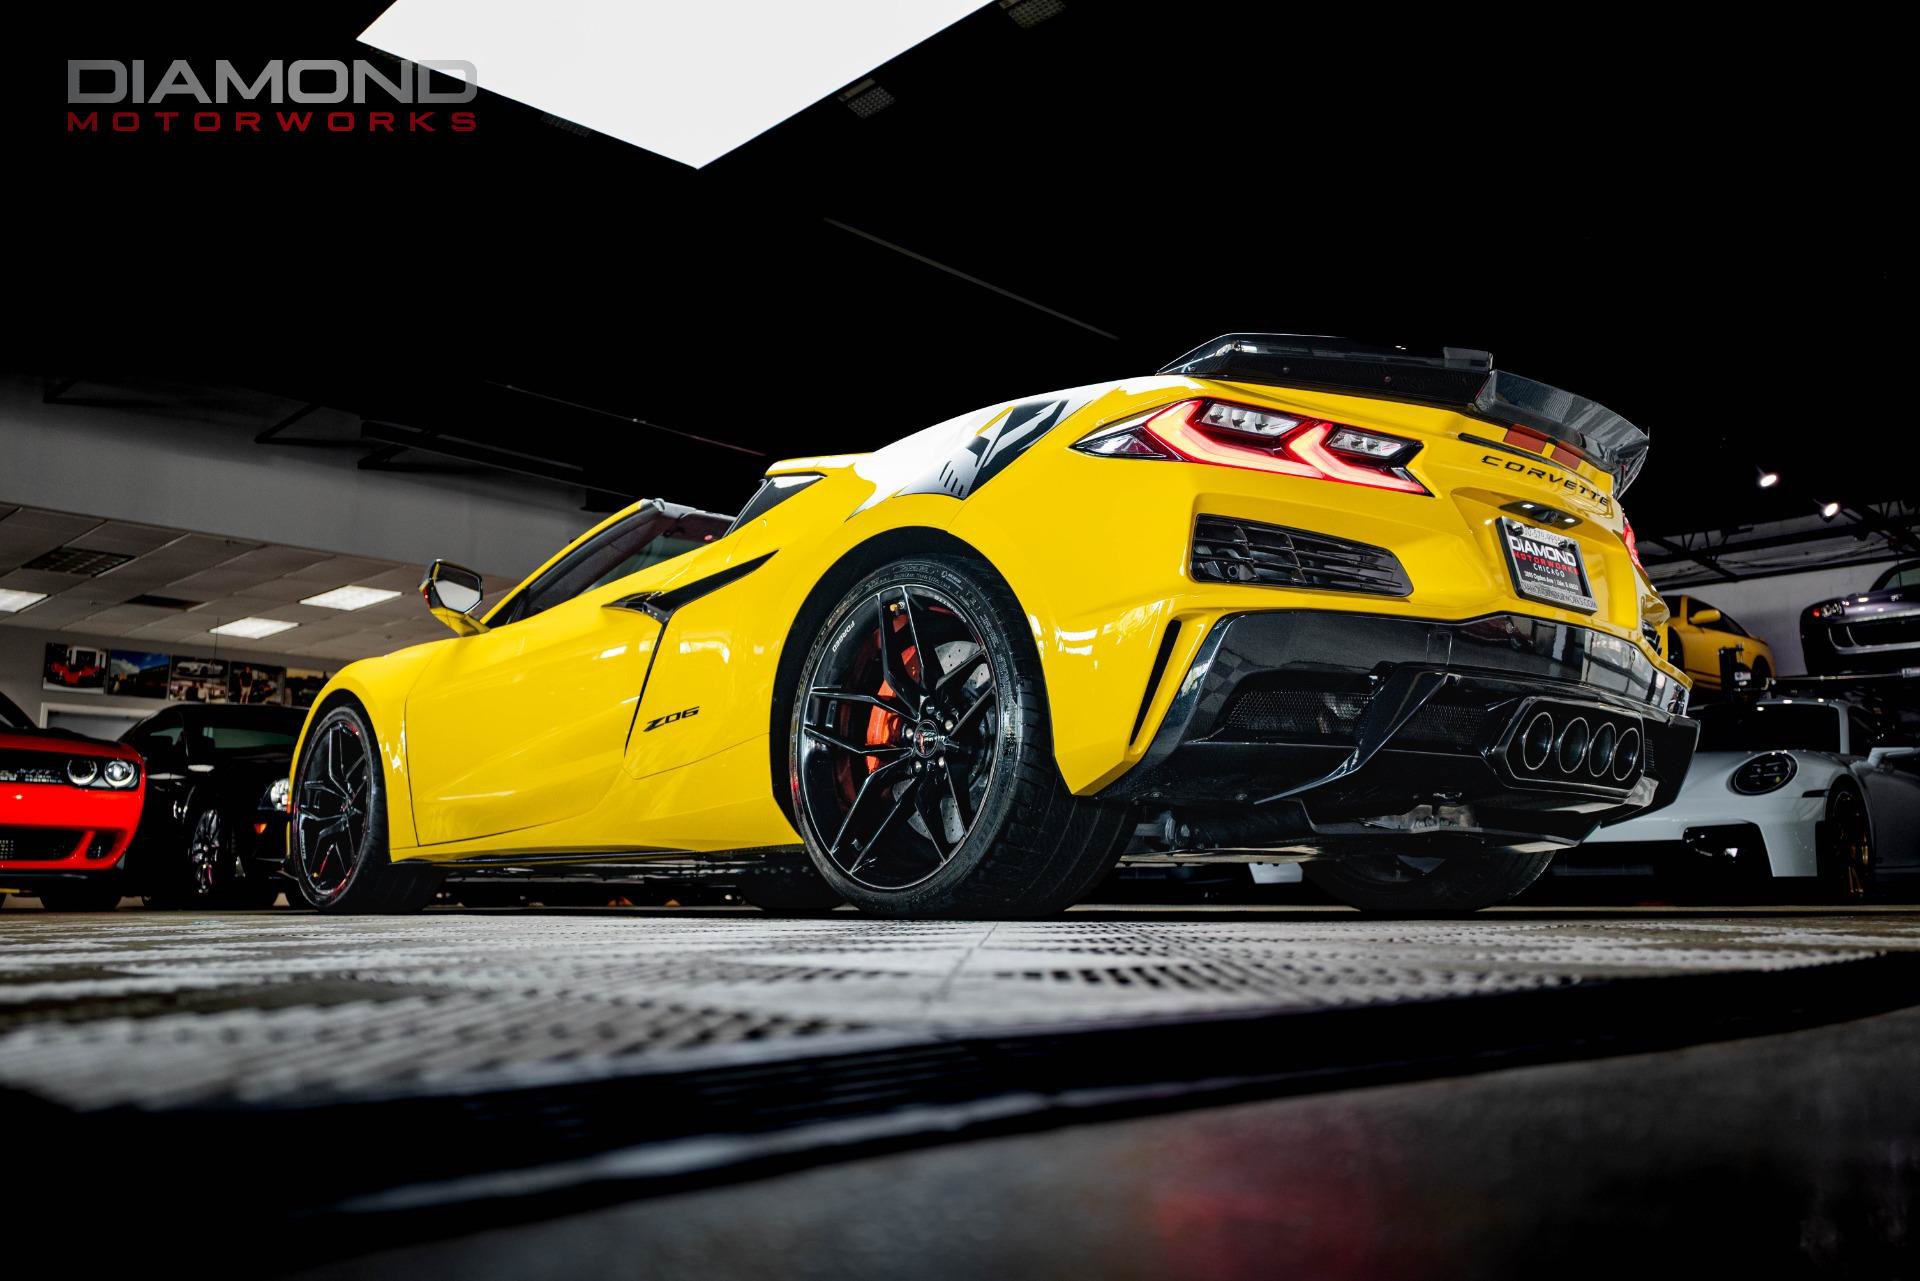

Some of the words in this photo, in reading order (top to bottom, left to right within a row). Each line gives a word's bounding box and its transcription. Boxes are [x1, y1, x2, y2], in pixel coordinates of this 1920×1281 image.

[1481, 455, 1609, 506] CORVETTE
[1509, 535, 1576, 567] DIAMOND
[1513, 549, 1579, 575] MOTORWORKS
[1533, 563, 1566, 578] CHICAGO
[643, 705, 700, 733] Z06
